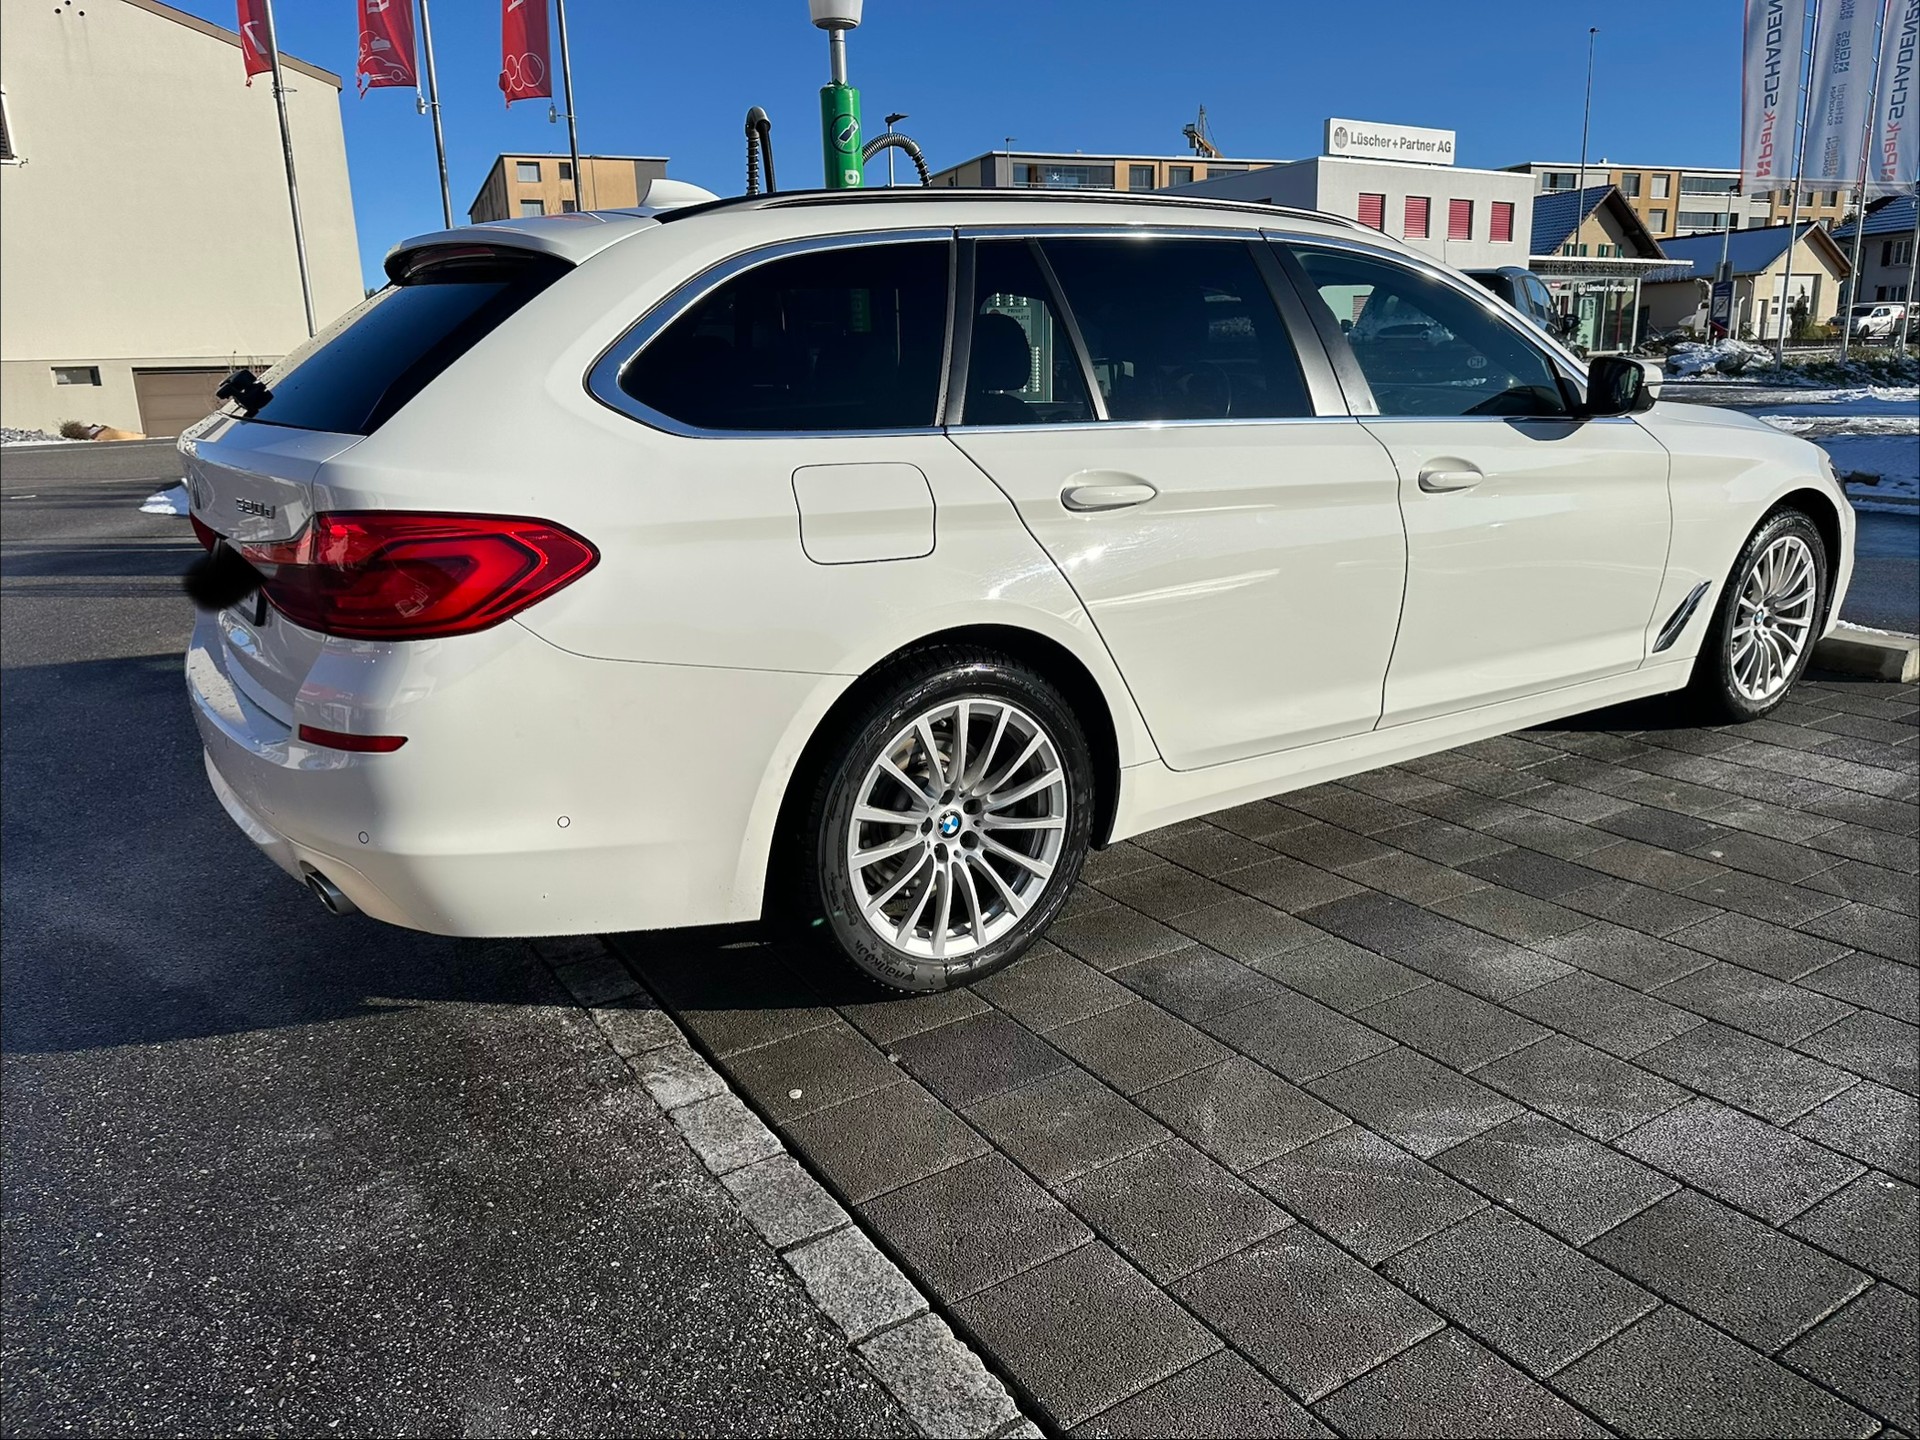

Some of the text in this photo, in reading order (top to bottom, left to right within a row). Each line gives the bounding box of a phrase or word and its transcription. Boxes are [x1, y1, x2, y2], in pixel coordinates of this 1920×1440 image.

[1350, 132, 1452, 153] Lüscher + Partner AG
[1470, 357, 1484, 367] CH
